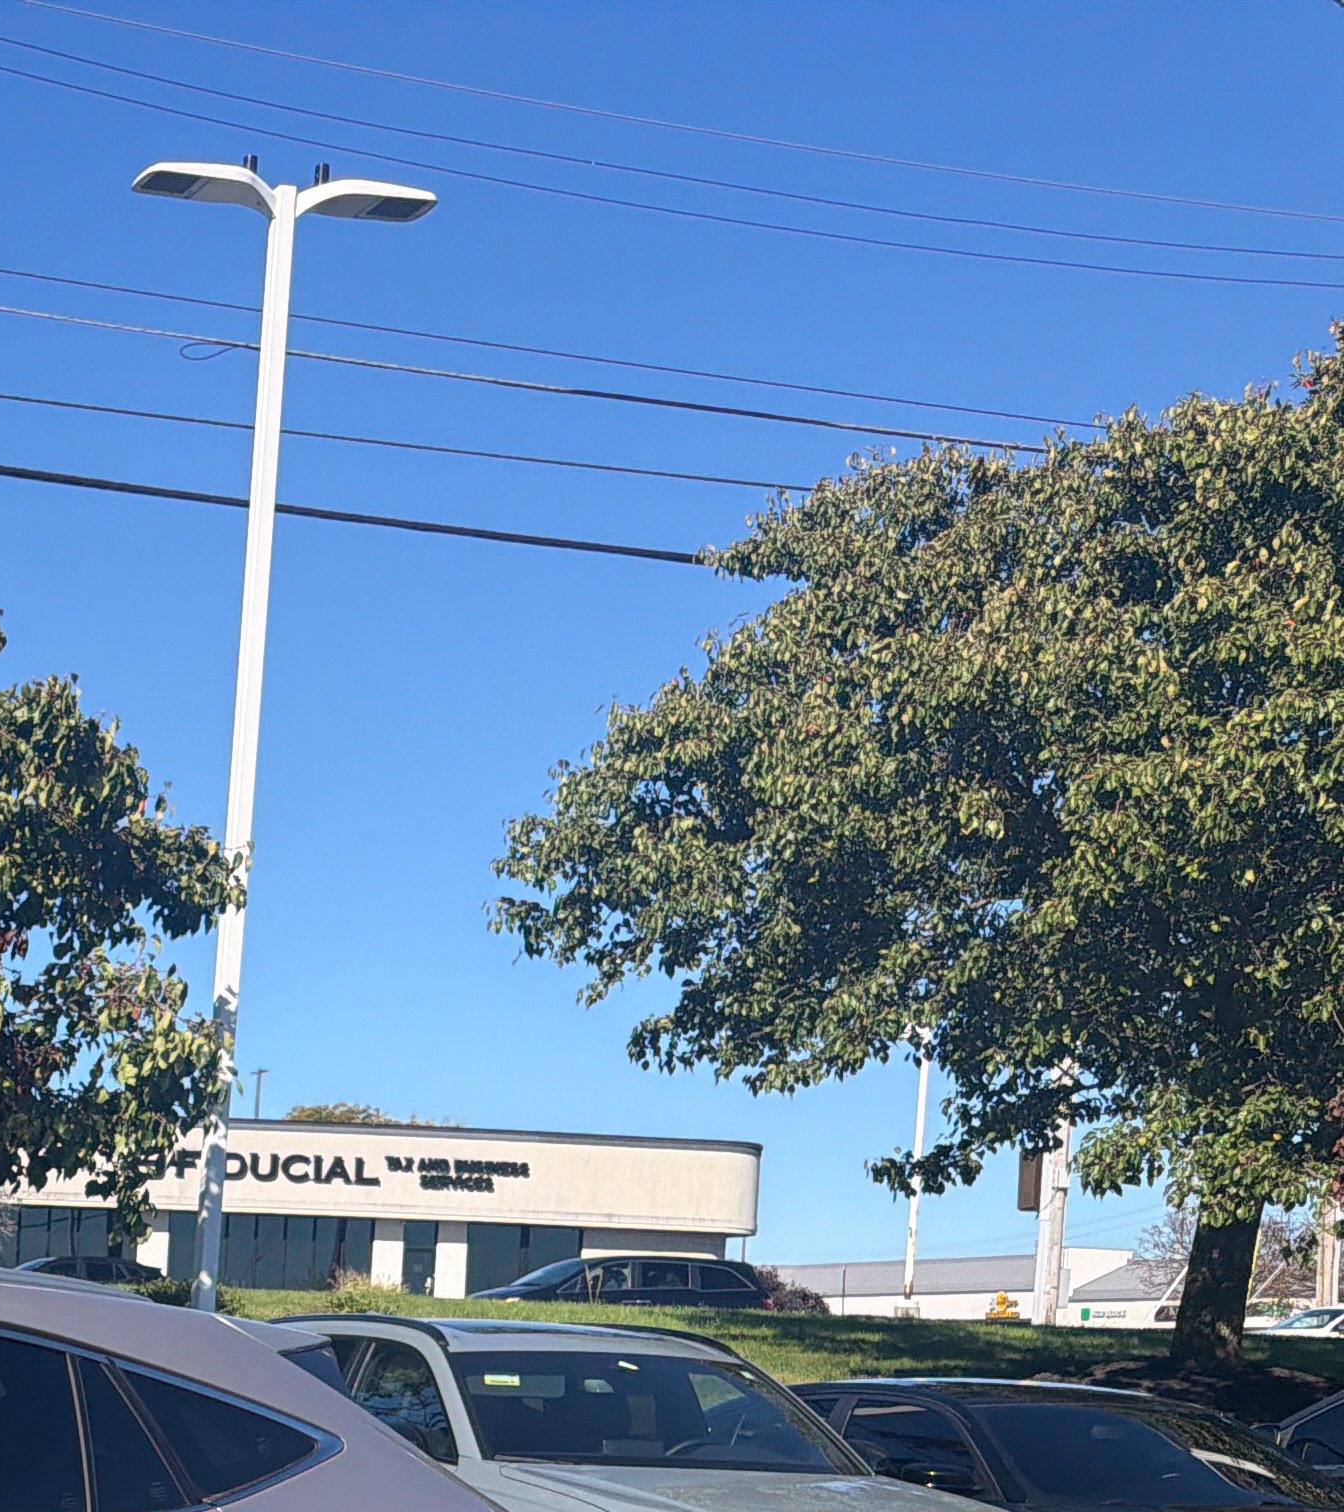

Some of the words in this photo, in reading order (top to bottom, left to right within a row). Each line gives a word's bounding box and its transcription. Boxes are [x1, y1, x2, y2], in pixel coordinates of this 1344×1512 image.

[175, 1149, 381, 1188] FDUCIAL
[417, 1157, 451, 1175] AND
[419, 1174, 495, 1193] SERVICES
